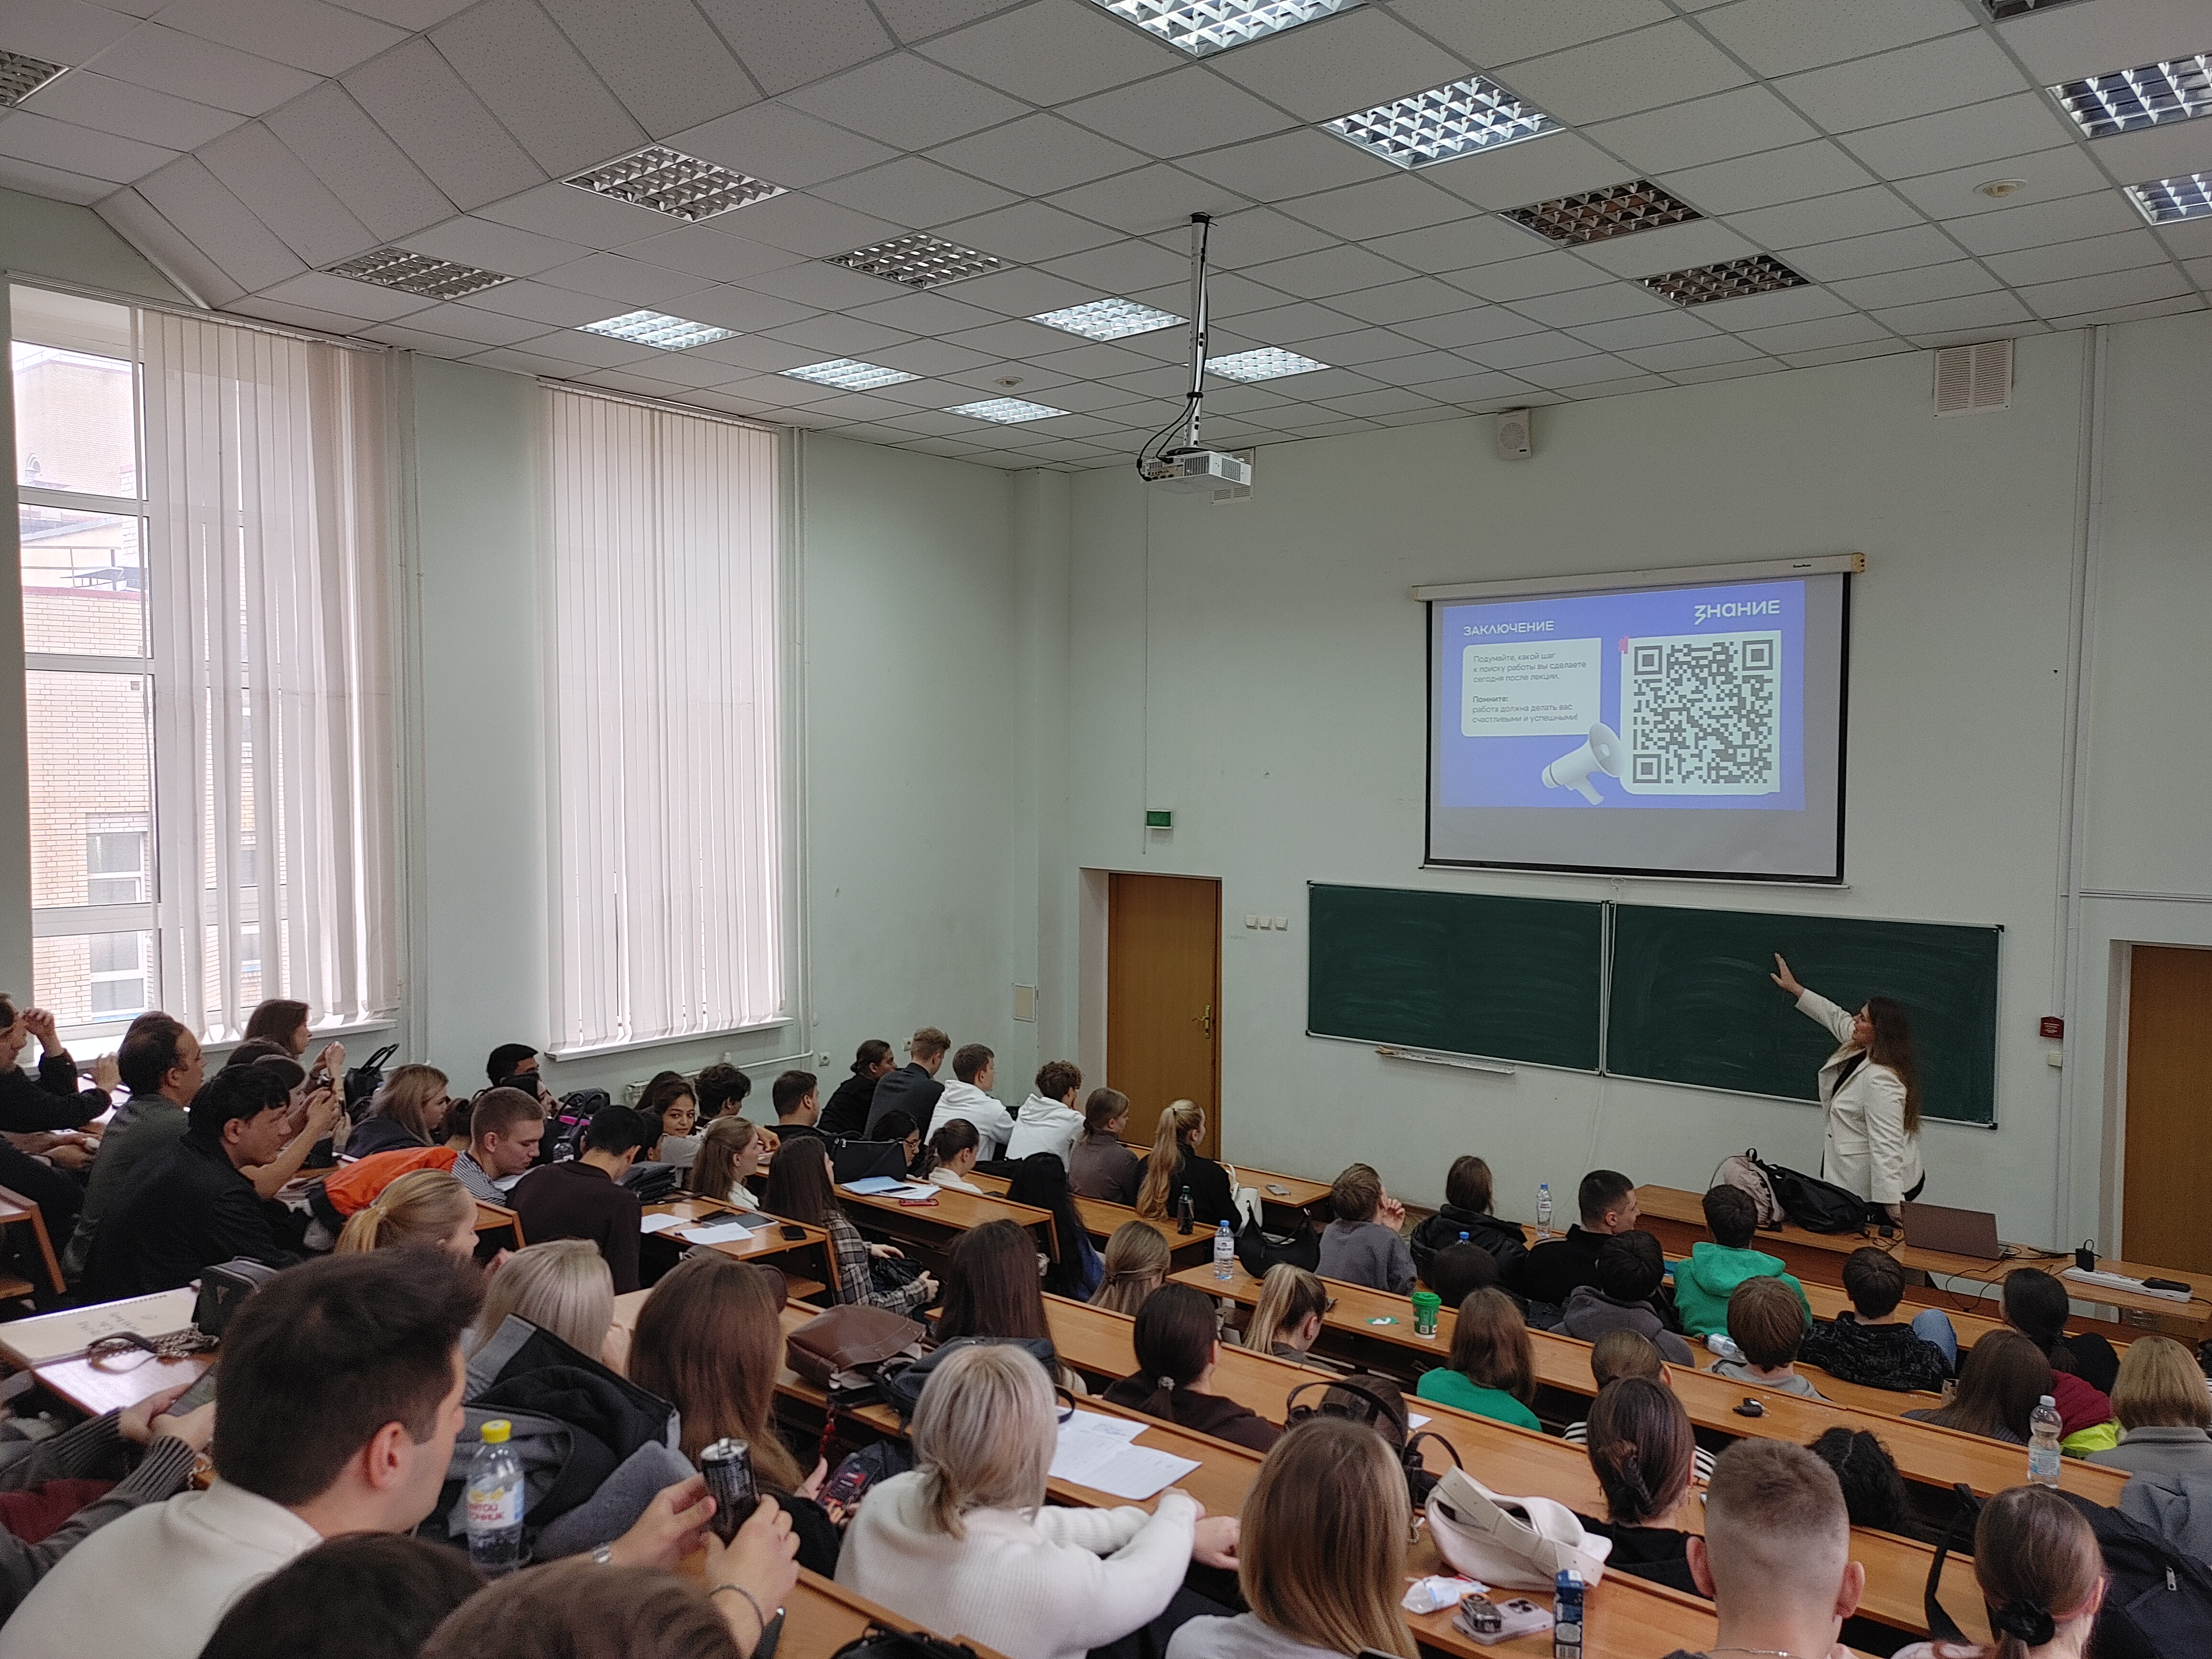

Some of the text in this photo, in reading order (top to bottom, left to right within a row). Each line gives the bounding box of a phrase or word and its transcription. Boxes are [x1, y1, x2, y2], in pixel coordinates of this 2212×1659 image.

[1463, 620, 1555, 636] ЗАКЛЮЧЕНИЕ
[1473, 654, 1516, 663] Подумайте,
[1518, 653, 1539, 661] какой
[1507, 663, 1536, 673] работы
[1472, 705, 1499, 714] работа
